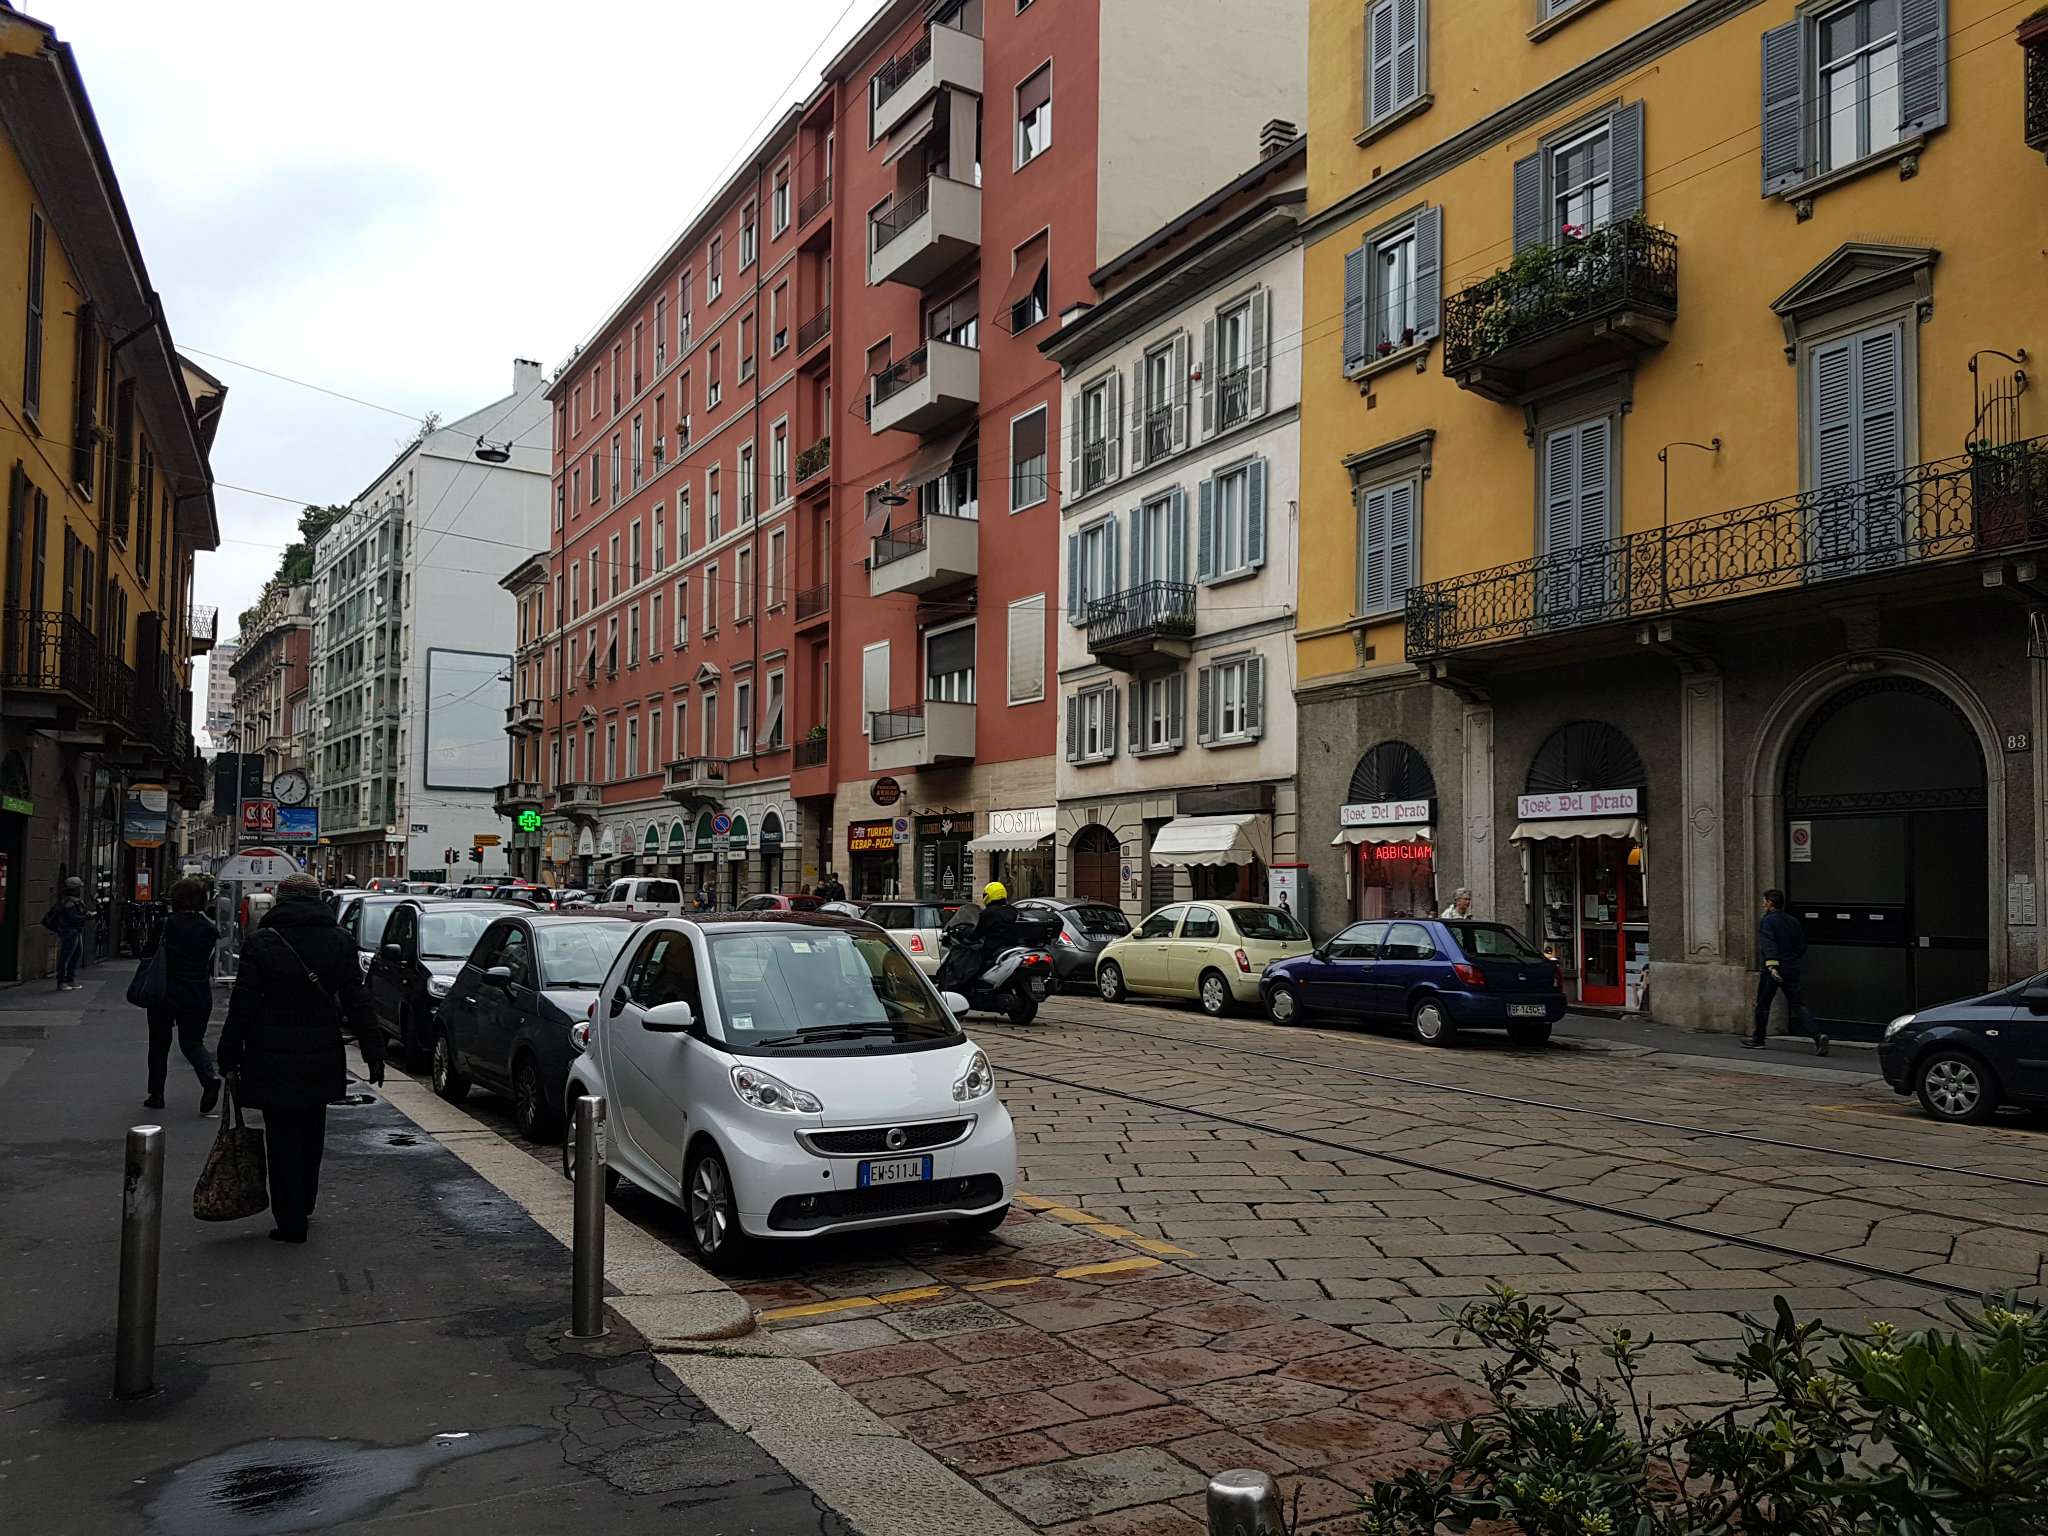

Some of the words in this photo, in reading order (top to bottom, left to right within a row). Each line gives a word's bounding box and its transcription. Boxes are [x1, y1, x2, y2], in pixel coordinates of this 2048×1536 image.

[2008, 734, 2026, 749] 83
[1558, 794, 1583, 811] Del
[1590, 793, 1633, 813] Prato
[1371, 804, 1389, 819] Del
[1395, 804, 1426, 821] Prato
[993, 811, 1042, 833] ROSITA
[1376, 845, 1432, 859] ABBIGLIAM
